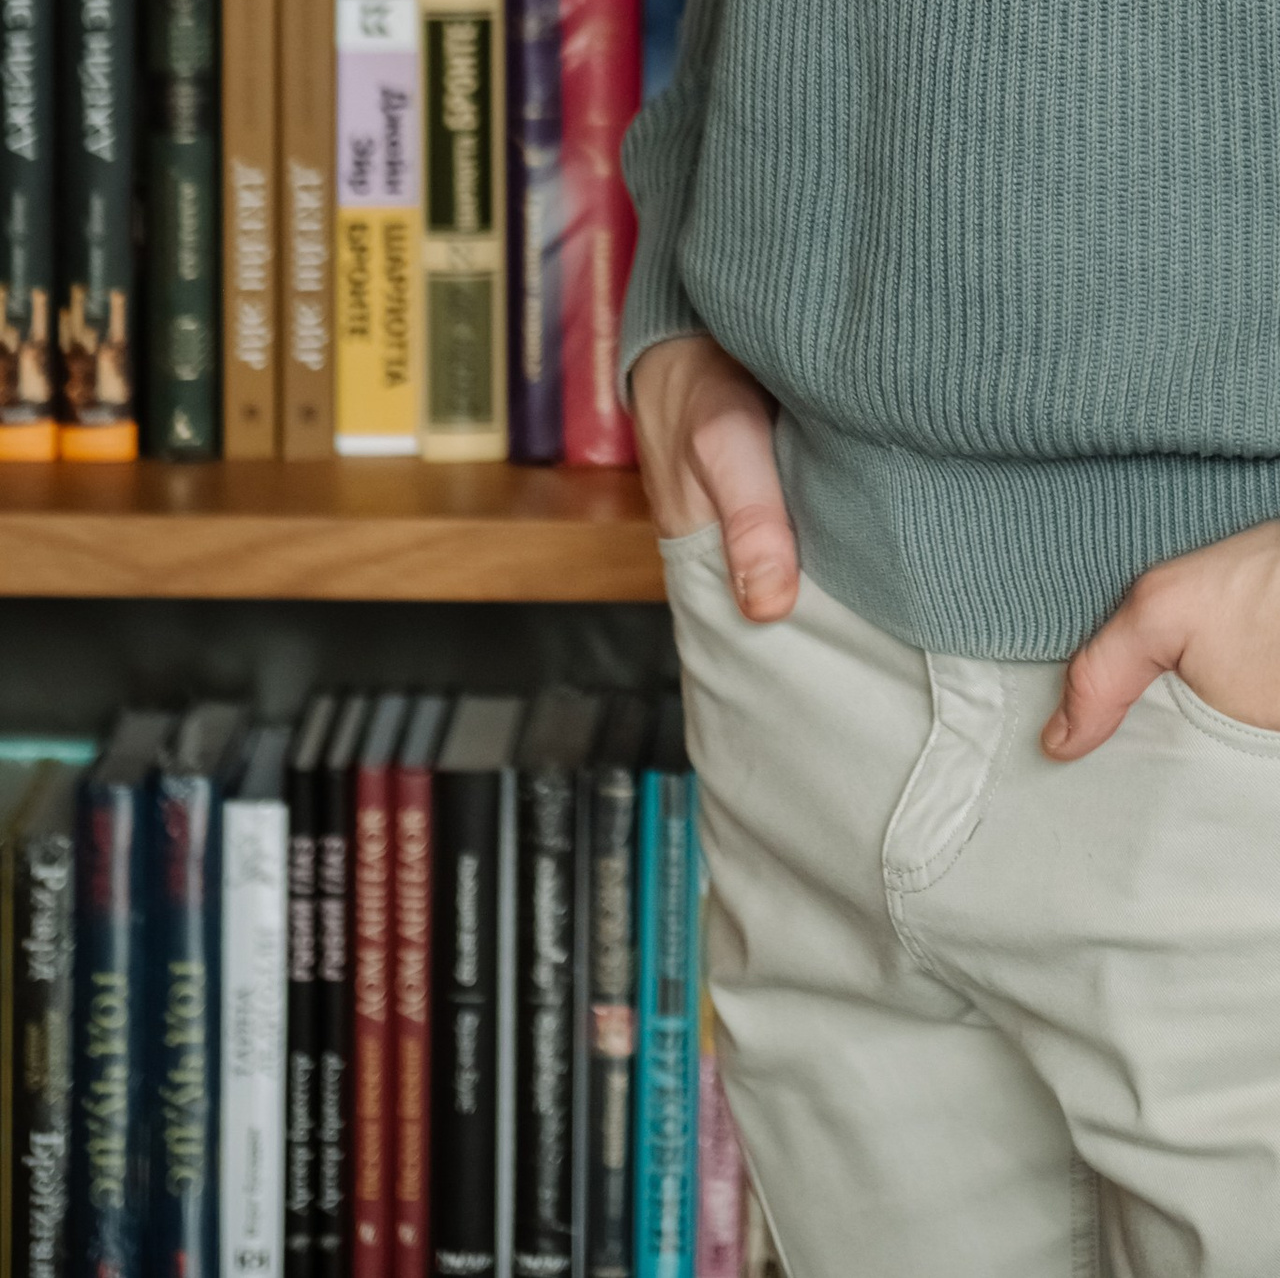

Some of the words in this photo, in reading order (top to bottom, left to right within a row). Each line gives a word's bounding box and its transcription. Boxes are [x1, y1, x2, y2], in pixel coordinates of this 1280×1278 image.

[3, 33, 38, 161] ДЖЕЙН
[78, 33, 115, 161] ДЖЕЙН
[442, 23, 480, 130] БРОНТЕ
[348, 137, 373, 196] Эйр
[379, 86, 407, 195] Джейн
[347, 222, 372, 340] БРОНТЕ
[383, 222, 409, 389] ШАРЛОТТА
